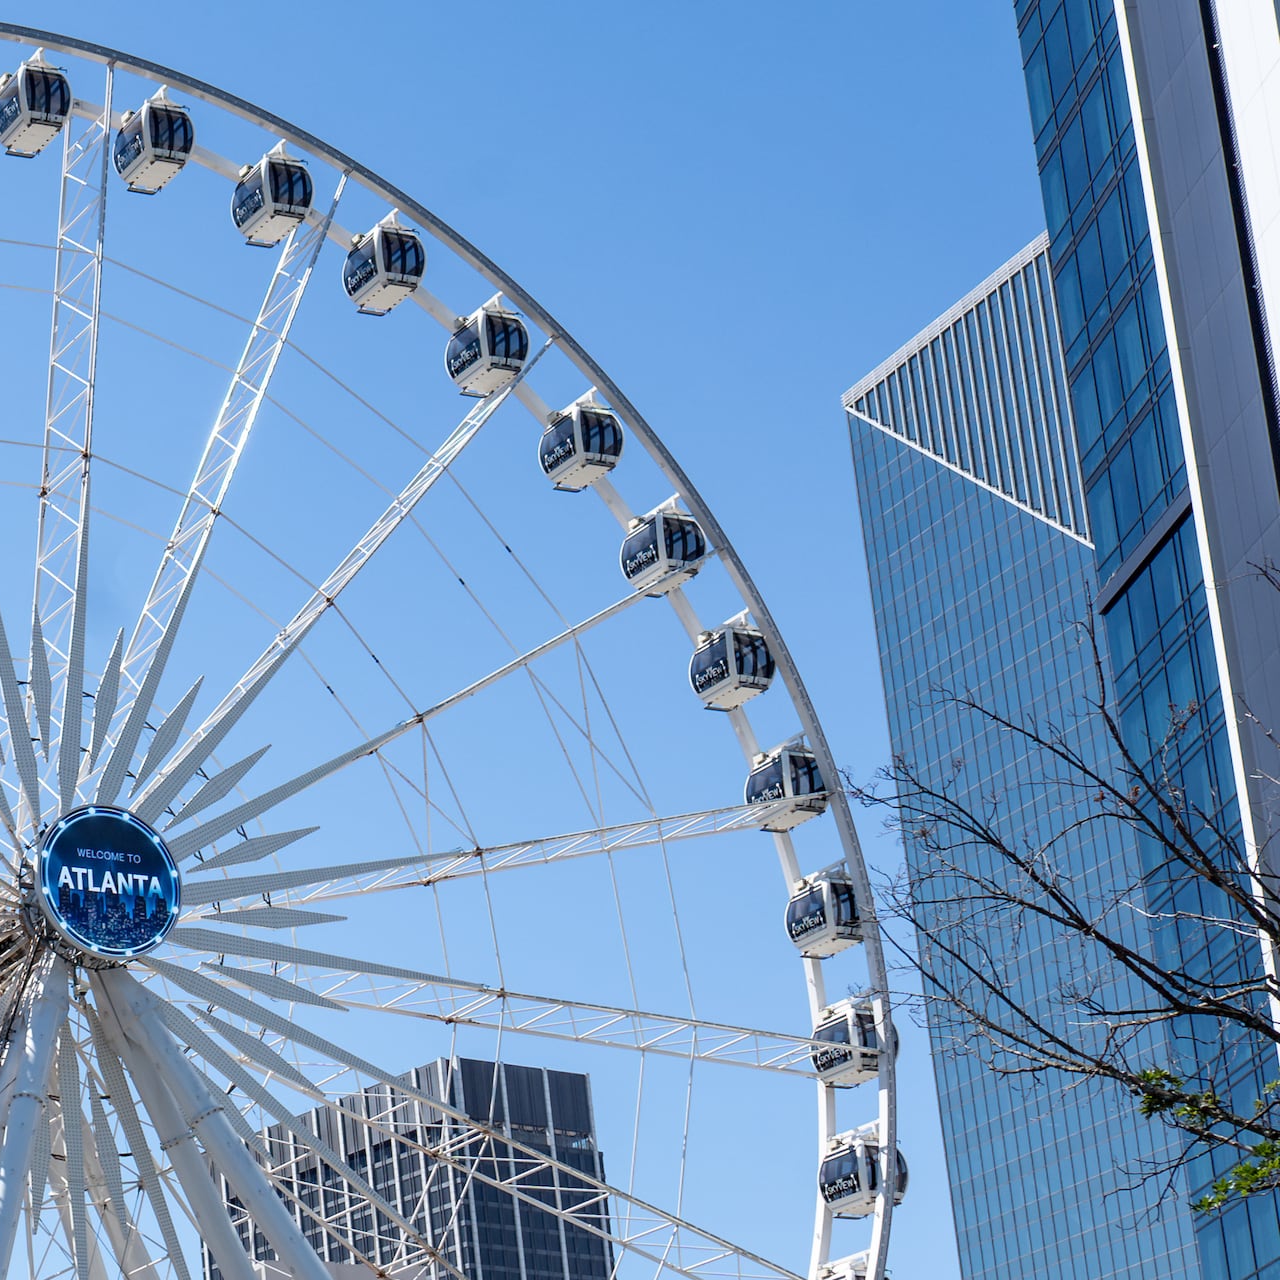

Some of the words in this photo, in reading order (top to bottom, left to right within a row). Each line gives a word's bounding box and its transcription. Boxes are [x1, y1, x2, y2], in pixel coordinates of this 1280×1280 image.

[76, 847, 125, 863] WELCOME
[127, 853, 141, 864] TO
[57, 865, 164, 899] ATLANTA
[795, 917, 819, 934] SKYVIEW
[828, 1180, 854, 1195] SKYVIEW
